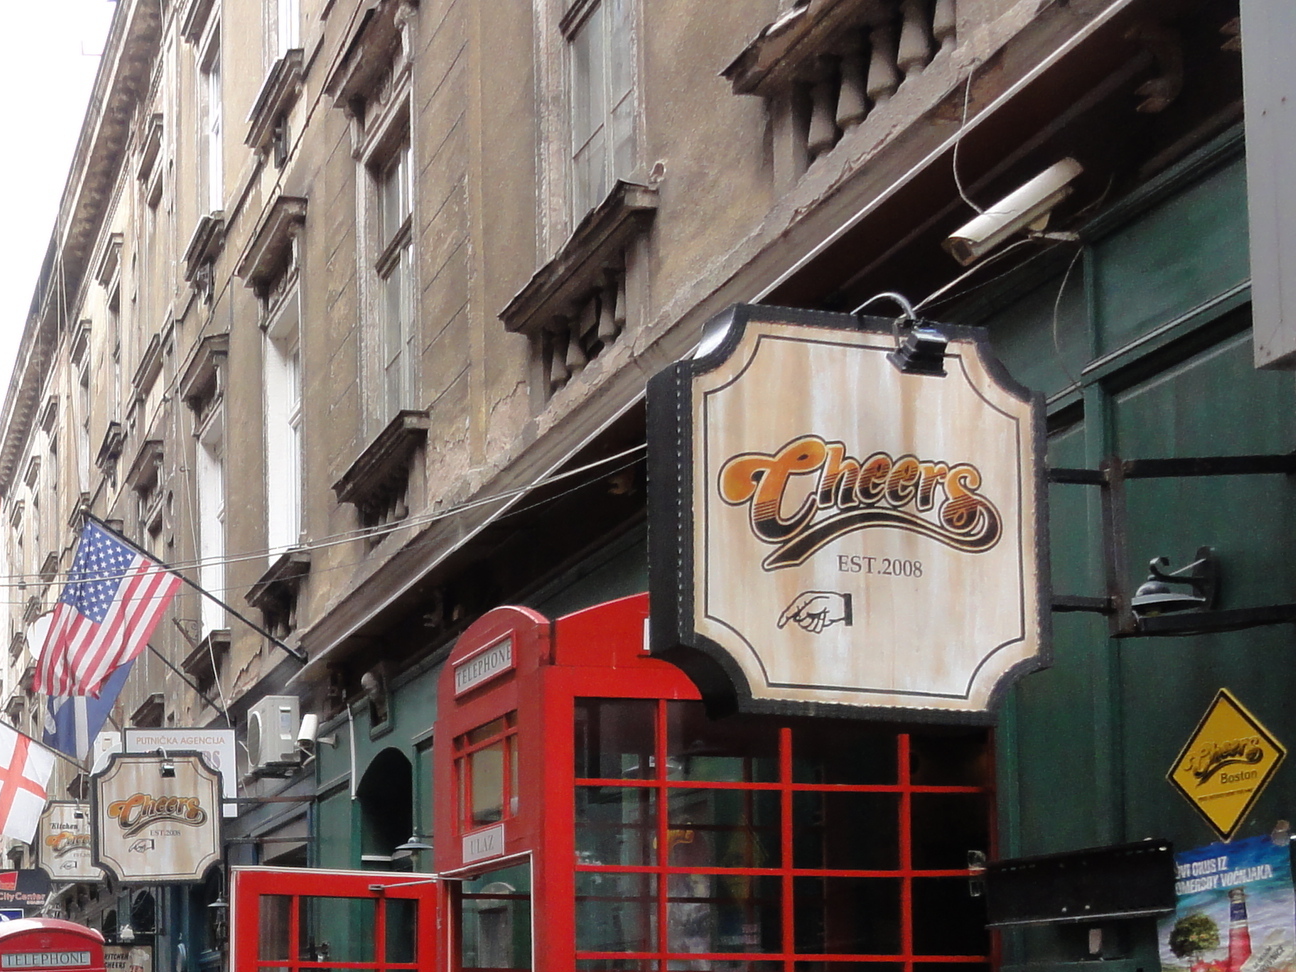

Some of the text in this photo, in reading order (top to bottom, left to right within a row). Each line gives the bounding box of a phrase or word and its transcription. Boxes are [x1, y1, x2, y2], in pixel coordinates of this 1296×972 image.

[717, 434, 1003, 572] Cheers
[837, 554, 923, 578] EST.2008
[456, 638, 513, 687] TELEPHONE
[136, 734, 225, 745] PUTNIČKA AGENCIJA
[1220, 770, 1258, 784] Boston
[107, 793, 207, 839] Cheers
[470, 835, 495, 855] ULAZ
[6, 953, 87, 967] TELEPHONE
